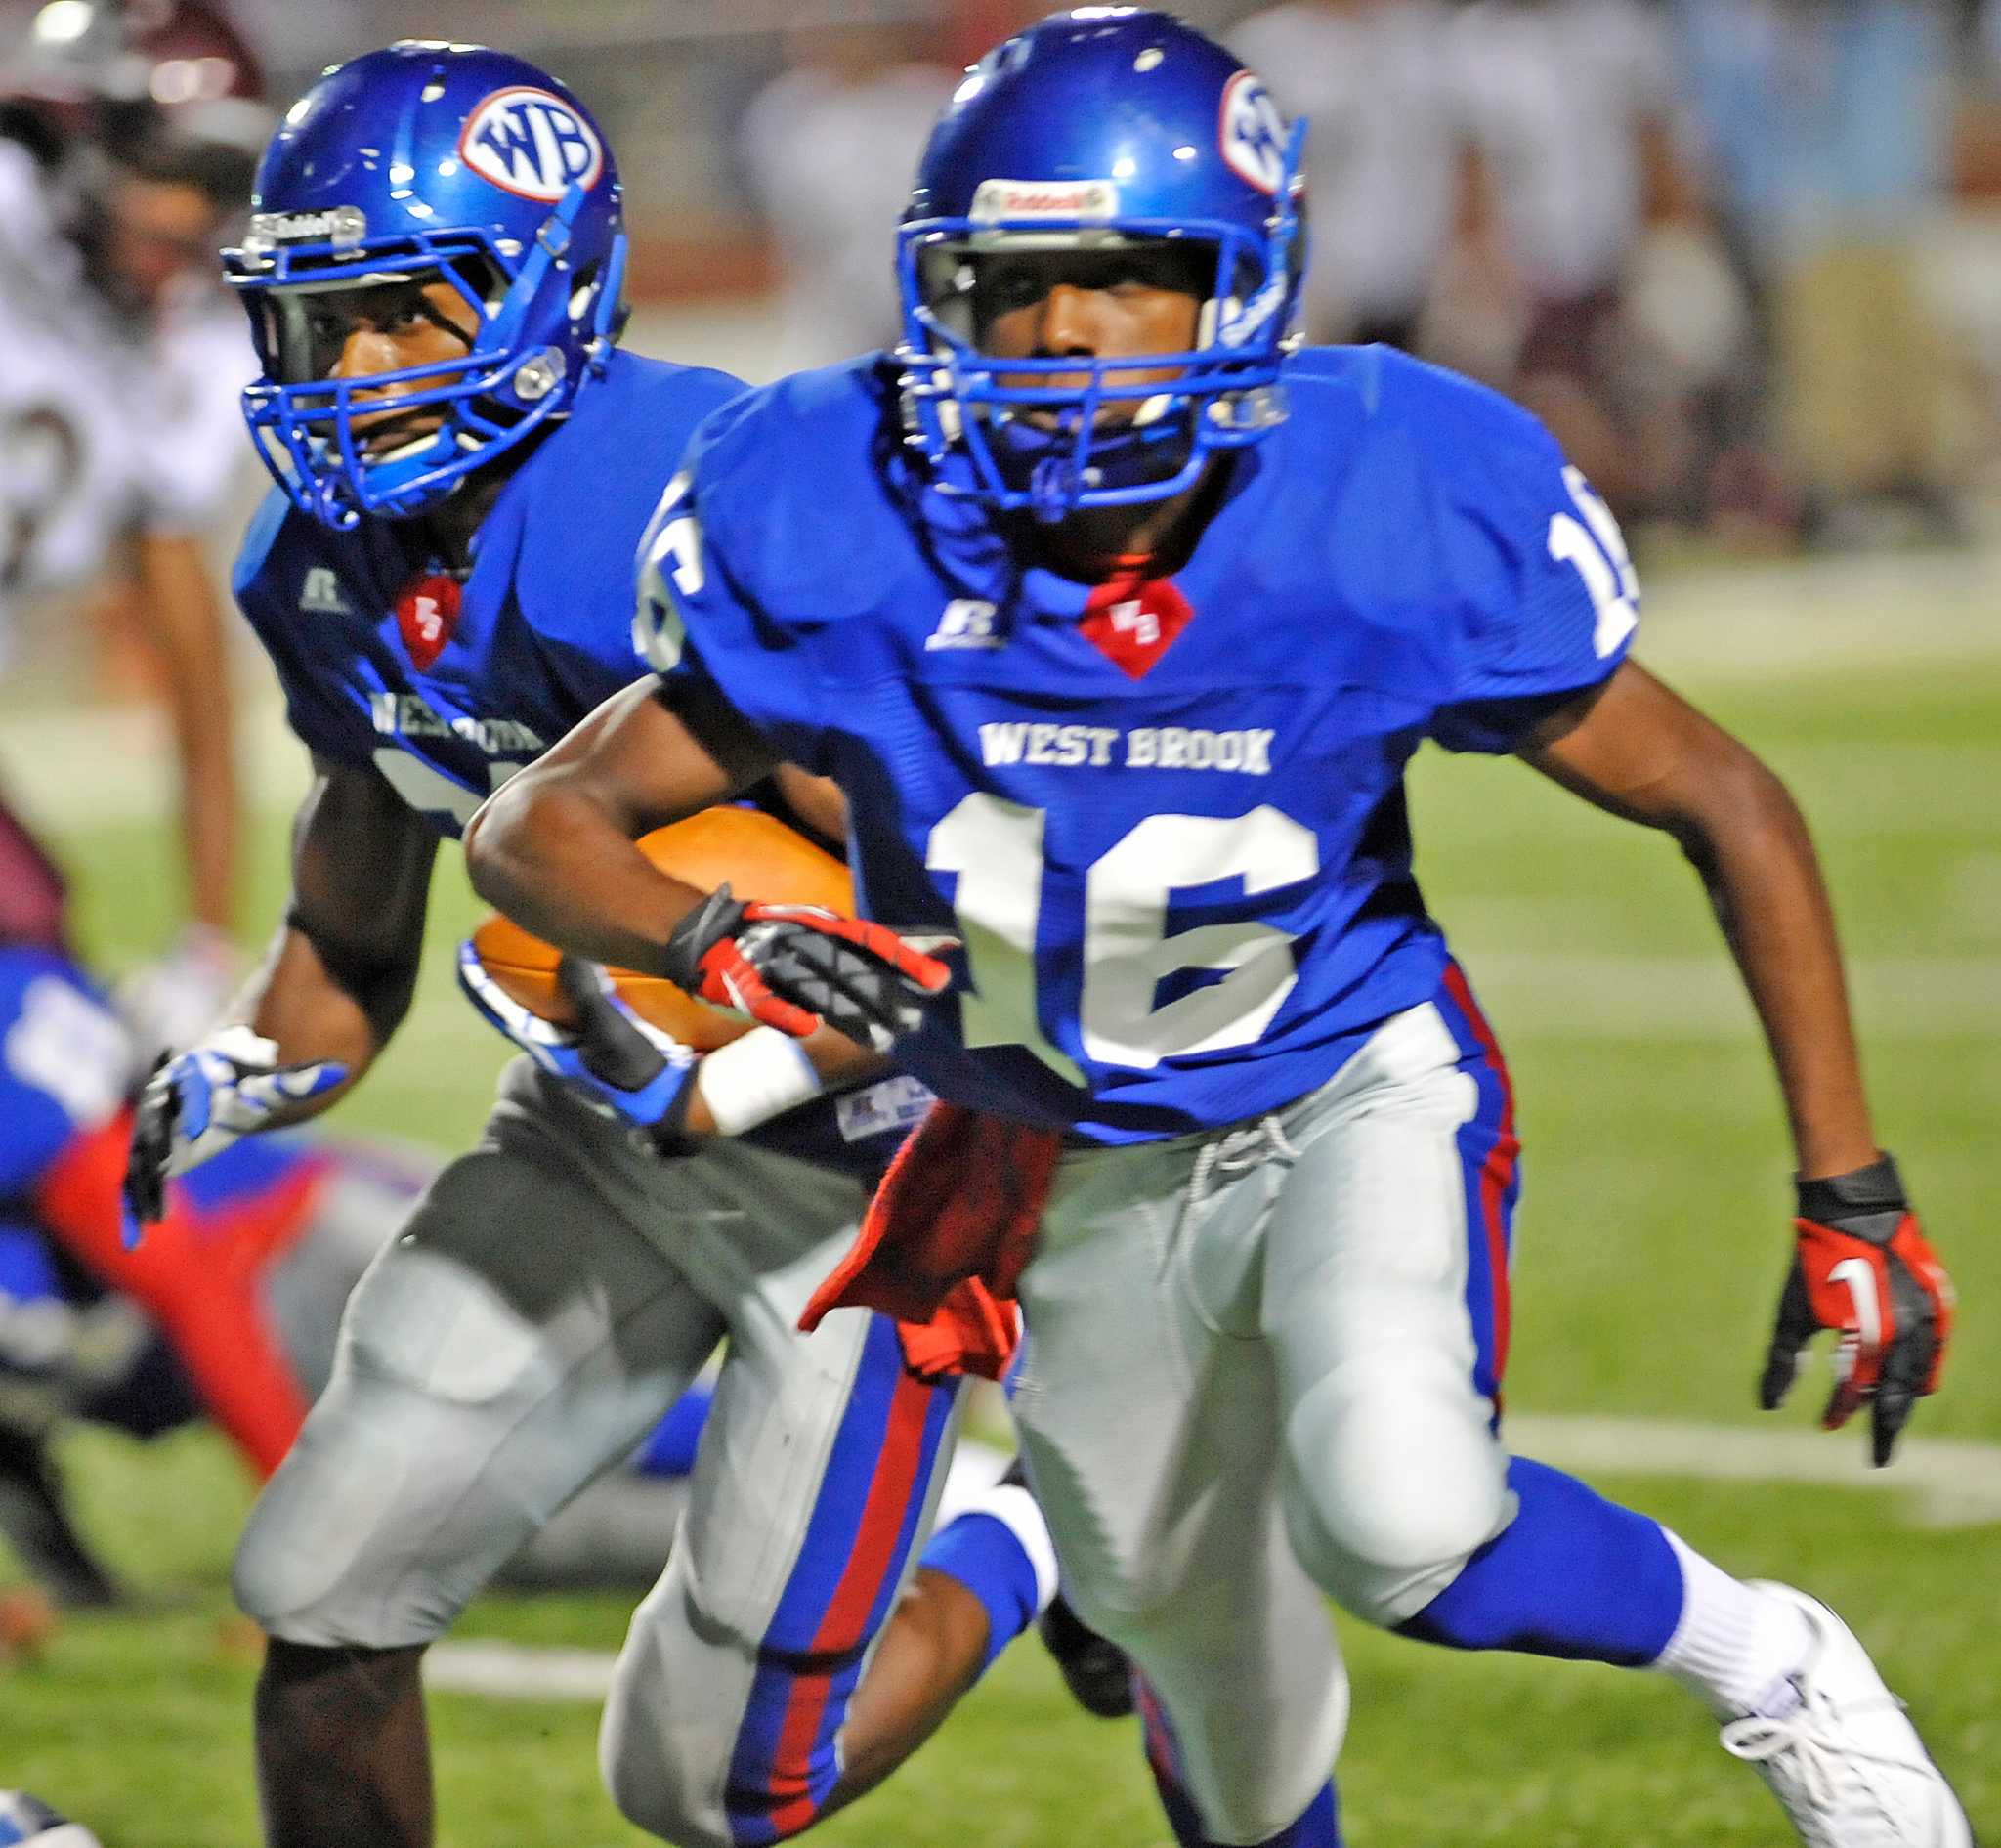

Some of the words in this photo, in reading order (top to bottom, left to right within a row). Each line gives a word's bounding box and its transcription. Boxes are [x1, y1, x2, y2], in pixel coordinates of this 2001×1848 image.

[475, 102, 593, 189] WB
[979, 722, 1119, 767] WEST
[1125, 727, 1274, 775] BROOK
[925, 791, 1320, 1089] 16
